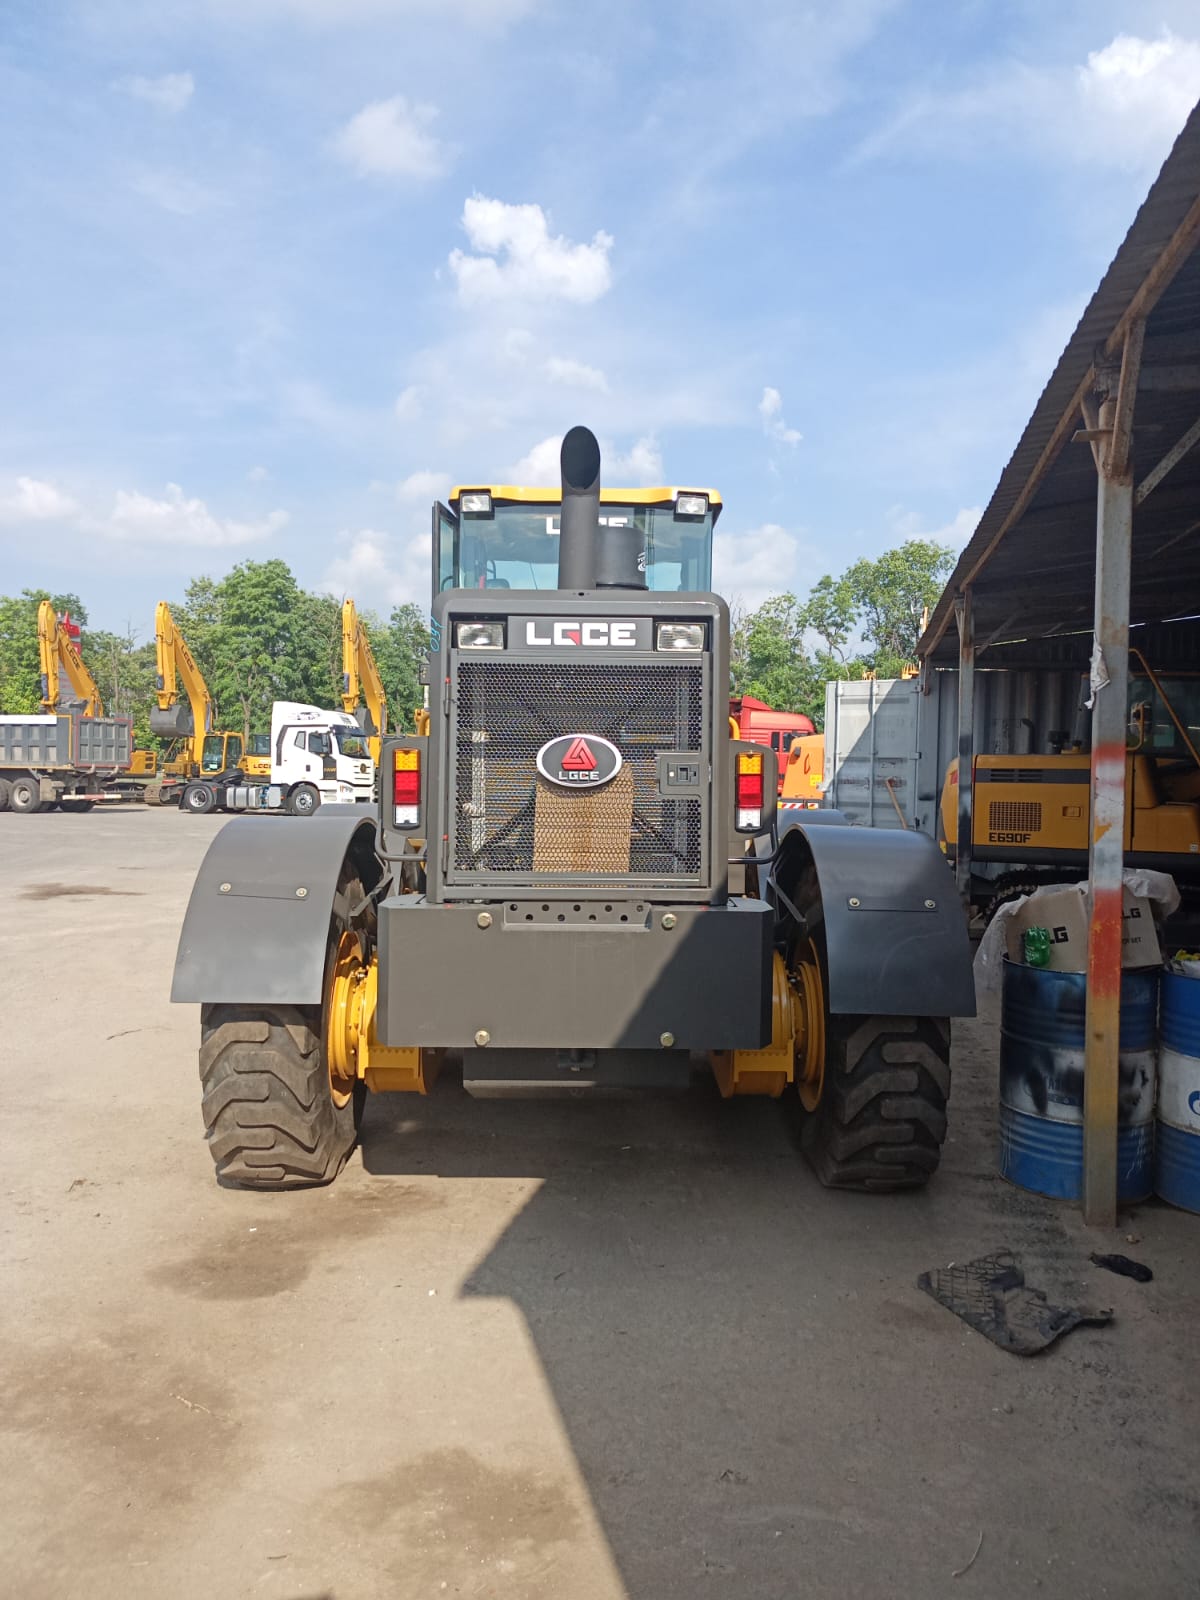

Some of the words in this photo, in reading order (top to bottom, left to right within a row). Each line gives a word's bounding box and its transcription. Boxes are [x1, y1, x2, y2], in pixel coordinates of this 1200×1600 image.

[526, 621, 637, 646] LGCE
[558, 770, 600, 780] LGCE
[988, 832, 1032, 844] E690F
